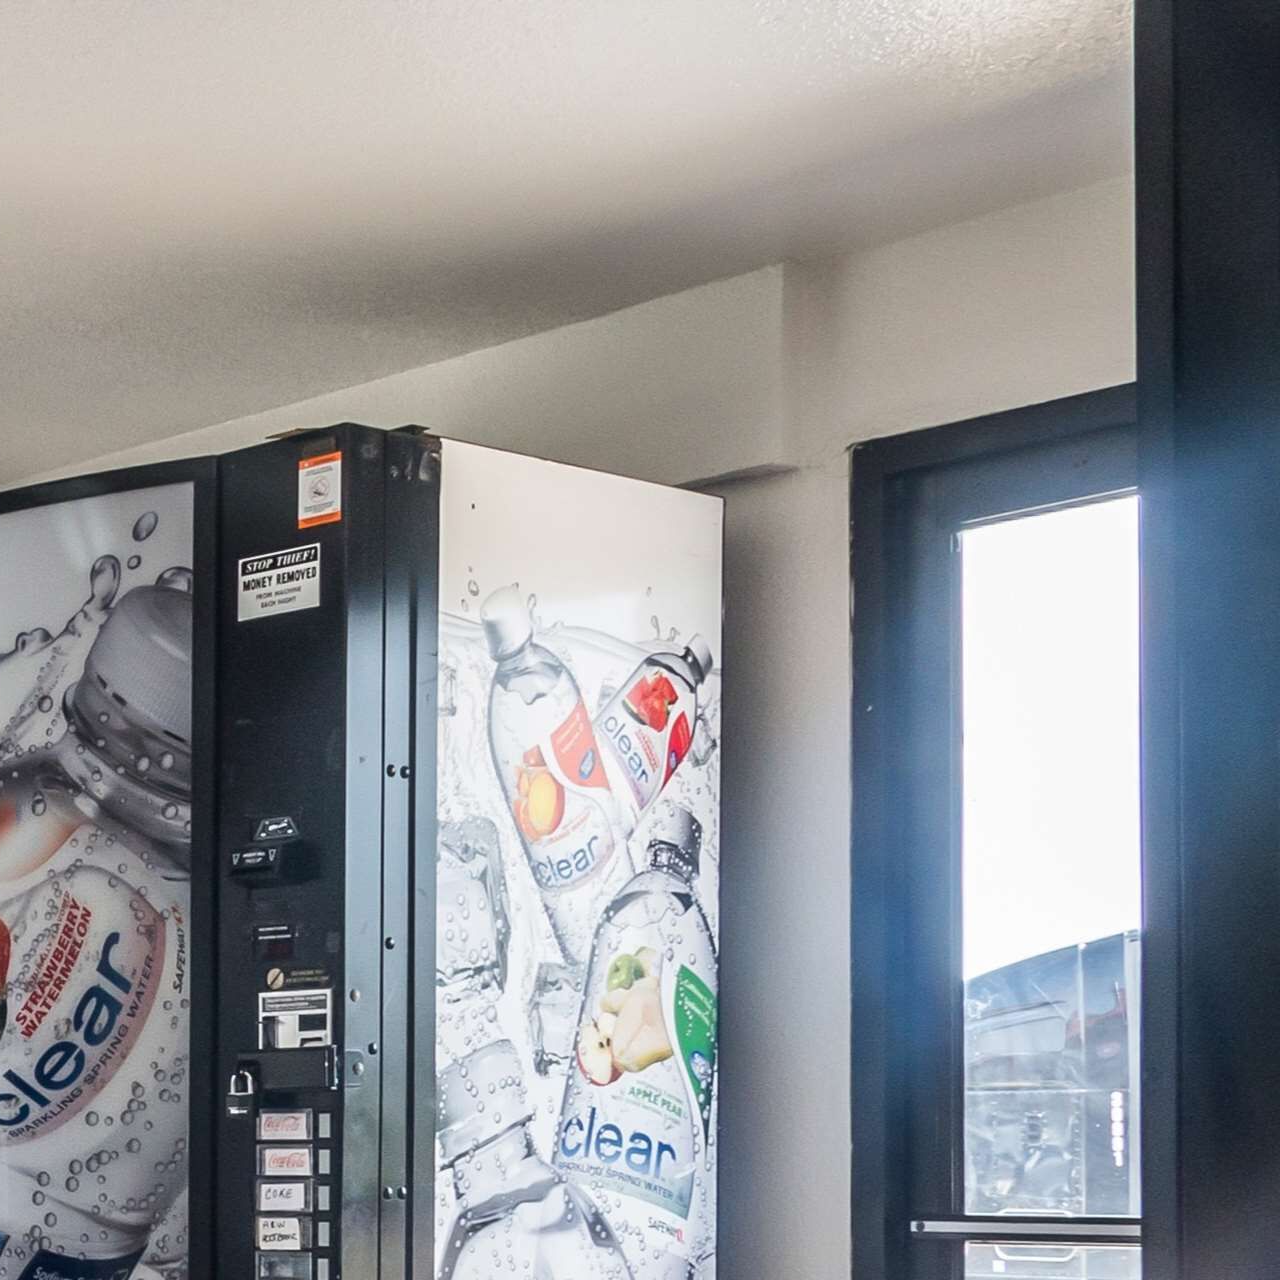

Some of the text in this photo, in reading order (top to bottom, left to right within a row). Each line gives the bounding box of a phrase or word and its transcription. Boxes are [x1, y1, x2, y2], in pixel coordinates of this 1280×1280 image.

[242, 566, 317, 592] MONEY REMOVED
[245, 548, 316, 574] STOP THIEF!
[604, 716, 649, 783] clear
[536, 835, 599, 886] clear
[15, 897, 81, 1026] STRAWBERRY
[20, 906, 92, 1040] WATERMELON
[172, 925, 186, 994] SAFEWAY
[8, 953, 155, 1138] SPARKLING SPRING WATER
[560, 1107, 677, 1178] clear
[264, 1188, 293, 1200] COKE
[643, 1181, 675, 1201] WATER
